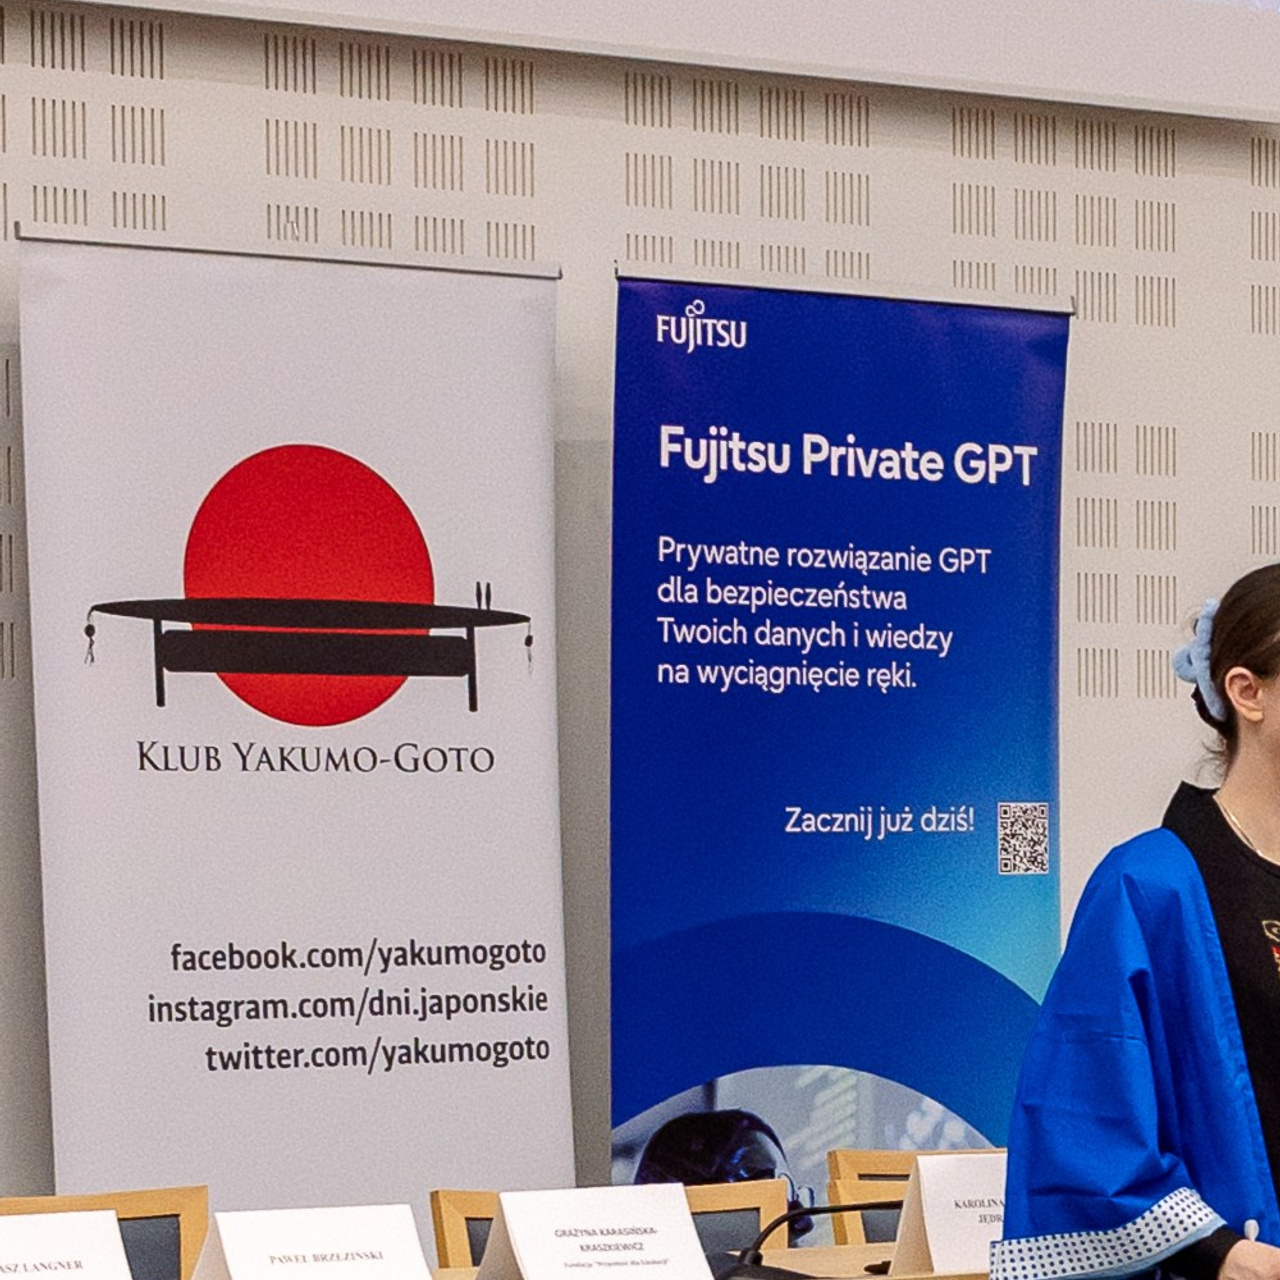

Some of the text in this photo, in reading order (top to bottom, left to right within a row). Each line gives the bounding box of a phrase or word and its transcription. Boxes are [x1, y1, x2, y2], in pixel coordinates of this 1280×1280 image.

[656, 300, 748, 354] FUJITSU
[660, 424, 1038, 487] Fujitsu Private GPT
[658, 535, 992, 576] Prywatne rozwiązanie GPT
[657, 577, 908, 613] dla bezpieczeństwa
[656, 616, 954, 658] Twoich danych i wiedzy
[657, 660, 917, 694] na wyciągnięcie ręki.
[137, 741, 495, 773] KLUB YAKUMO-GOTO
[784, 805, 975, 841] Zacznij już dziś!
[171, 937, 547, 976] facebook.com/yakumogoto
[148, 984, 548, 1027] instagram.com/dni.japonskie
[205, 1036, 550, 1075] twitter.com/yakumogoto
